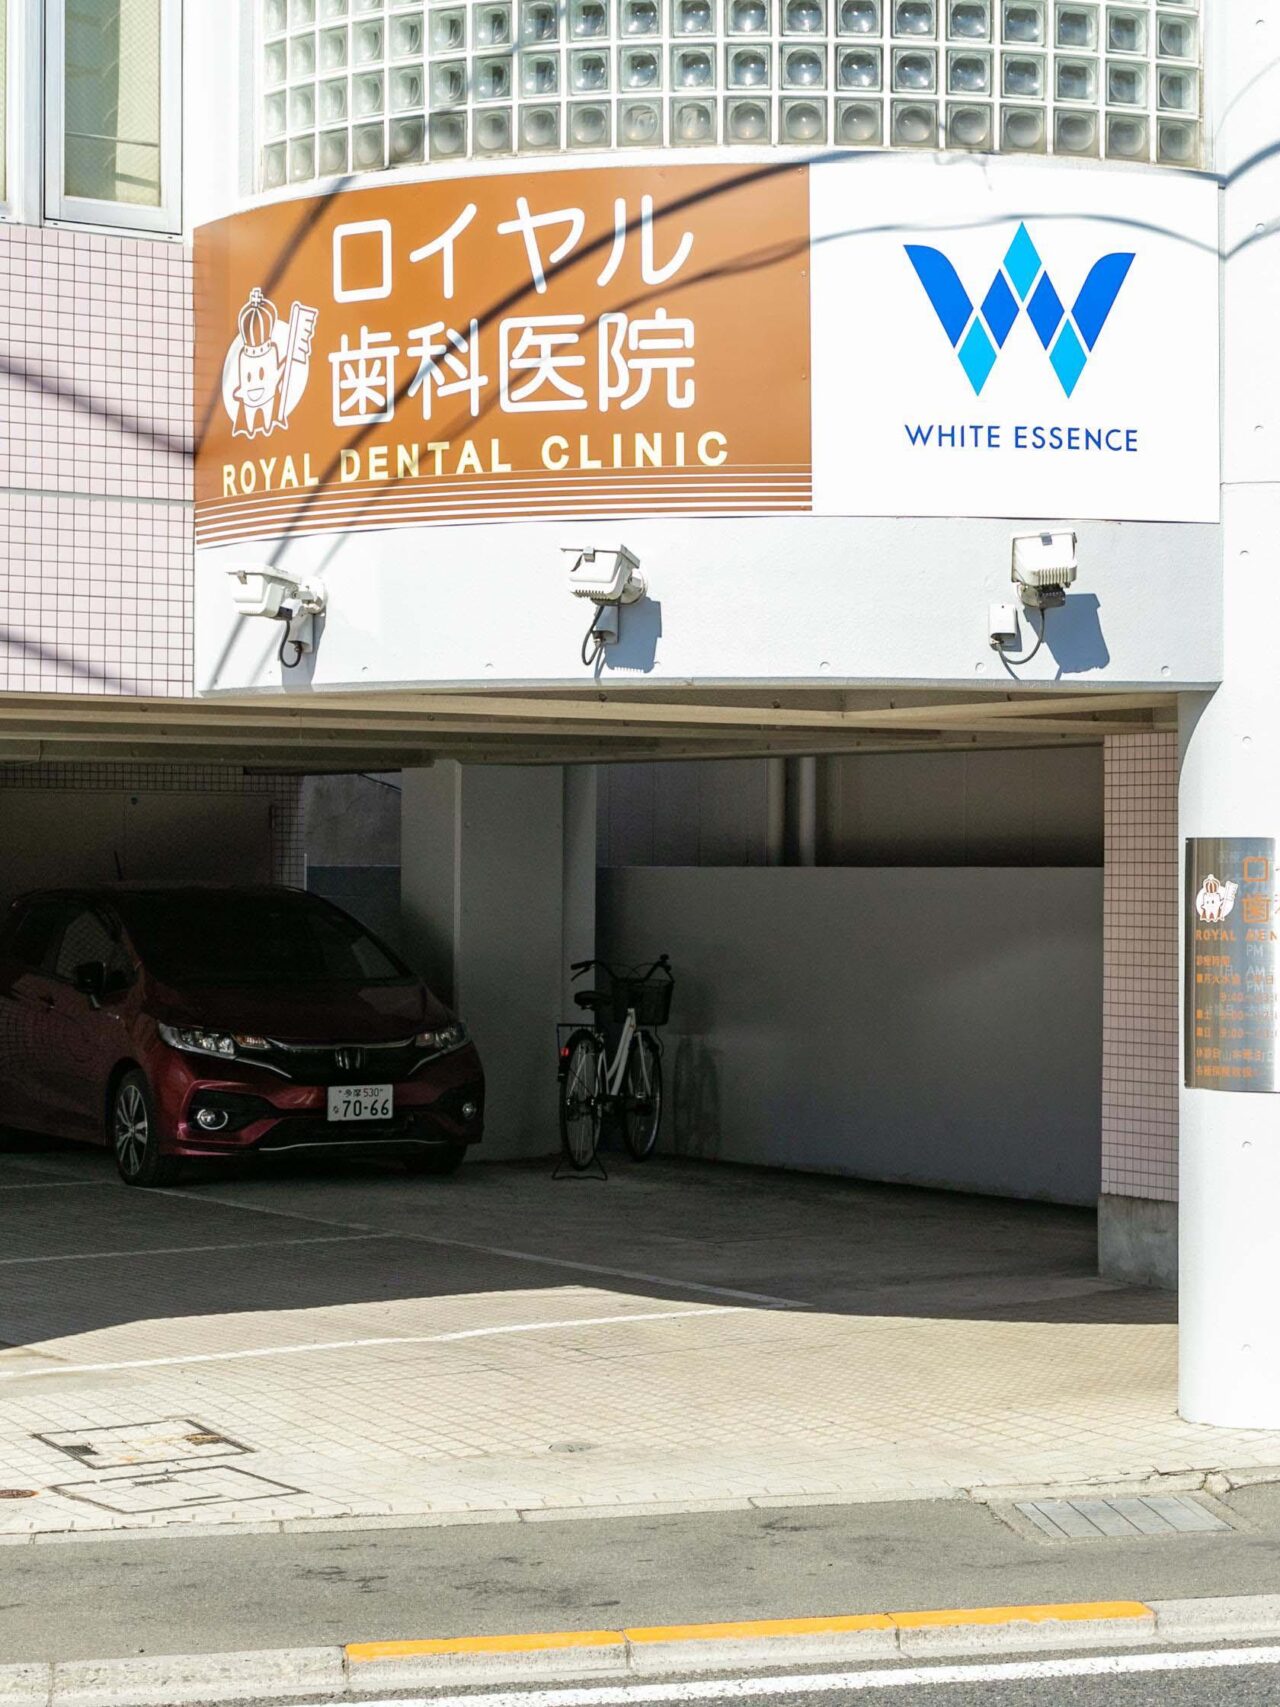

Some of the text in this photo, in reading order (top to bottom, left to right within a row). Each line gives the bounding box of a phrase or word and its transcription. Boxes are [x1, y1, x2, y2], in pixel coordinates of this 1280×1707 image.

[331, 194, 694, 303] ロイヤル
[328, 306, 695, 427] 歯科医院
[905, 424, 1138, 452] WHITE ESSENCE
[223, 430, 729, 498] ROYAL DENTAL CLINIC
[1195, 929, 1237, 941] ROYAL
[363, 1088, 379, 1097] 530
[342, 1099, 389, 1117] 70-66
